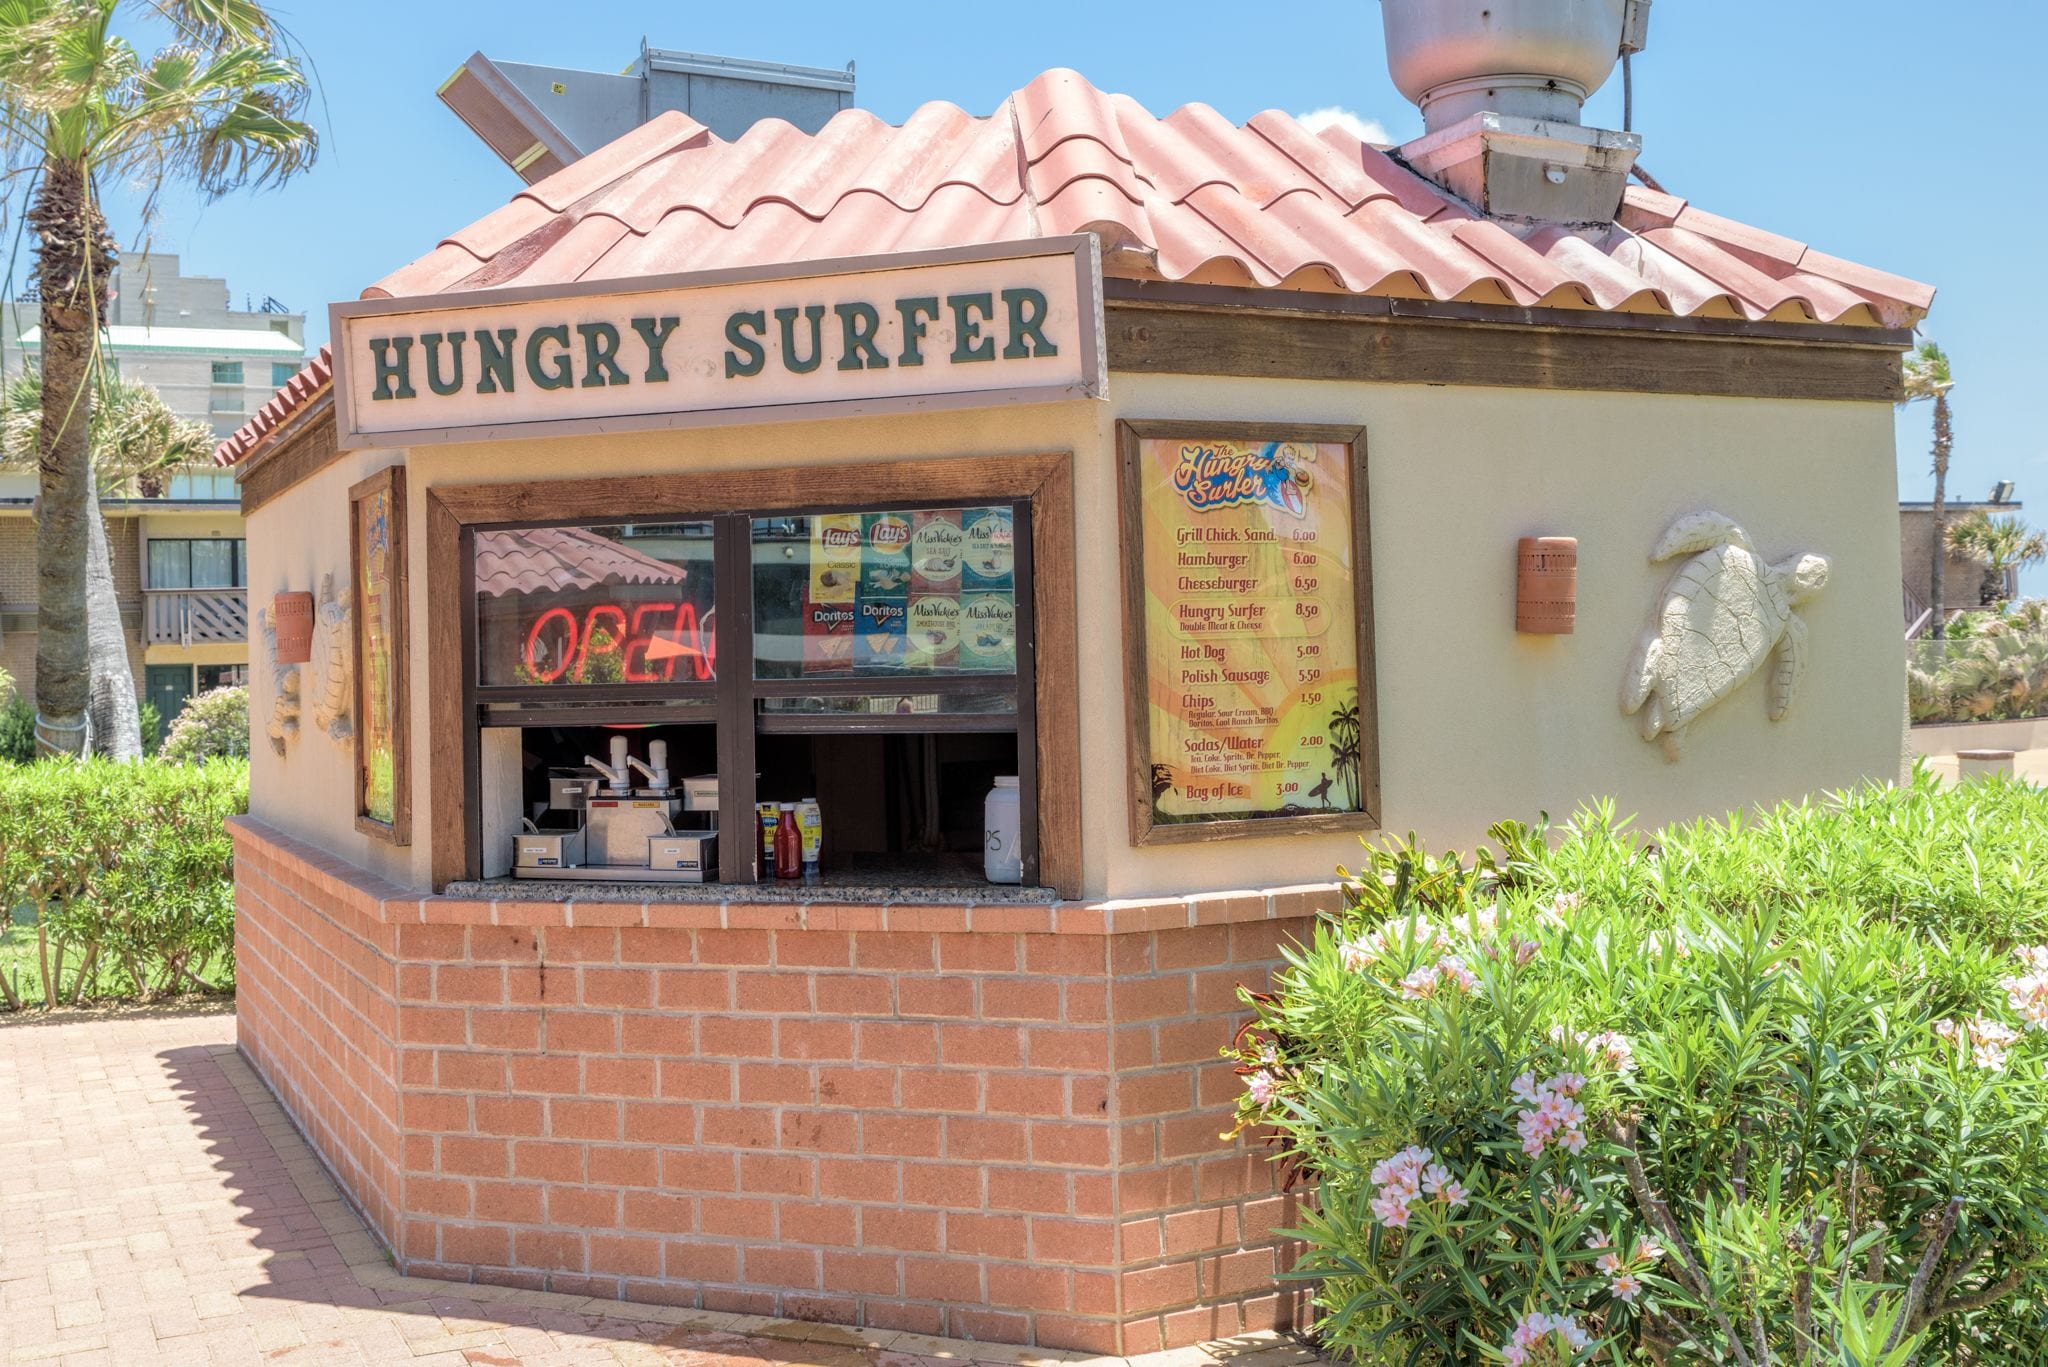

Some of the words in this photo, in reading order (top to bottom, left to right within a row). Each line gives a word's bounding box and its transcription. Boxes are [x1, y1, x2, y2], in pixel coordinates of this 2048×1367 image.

[369, 317, 681, 400] HUNGRY
[723, 288, 1059, 379] SURFER
[1213, 444, 1235, 457] The
[1174, 446, 1271, 490] Hungry
[1187, 468, 1267, 506] Surfer
[1177, 528, 1203, 545] Grill
[1206, 528, 1241, 541] Chick.
[1244, 528, 1277, 541] Sand.
[1293, 529, 1316, 541] 6.00
[827, 560, 856, 569] Classic
[1178, 552, 1248, 569] Hamburger
[1293, 552, 1317, 564] 6.00
[1178, 576, 1258, 593] Cheeseburger
[1295, 576, 1317, 591] 6.50
[814, 611, 854, 622] Doritos
[863, 605, 904, 617] Doritos
[1180, 604, 1225, 621] Hungry
[1228, 604, 1265, 620] Surfer
[1296, 603, 1318, 617] 8.50
[1180, 621, 1206, 631] Double
[1208, 621, 1228, 631] Meat
[1229, 621, 1236, 630] &
[1237, 620, 1262, 630] Cheese
[1181, 646, 1201, 659] Hot
[1204, 645, 1225, 661] Dog
[1297, 645, 1320, 658] 5.00
[1182, 669, 1218, 683] Polish
[1222, 669, 1270, 684] Sausage
[1299, 669, 1320, 682] 5.50
[1182, 694, 1215, 710] Chips
[1301, 693, 1321, 705] 1.50
[1218, 709, 1233, 718] Sour
[1261, 707, 1274, 716] BBQ
[1216, 718, 1230, 727] Cool
[1232, 716, 1253, 726] Ranch
[1255, 715, 1279, 725] Doritos
[1185, 736, 1264, 753] Sodas/Water
[1300, 736, 1323, 746] 2.00
[1246, 752, 1255, 760] Dr.
[1191, 766, 1204, 774] Diet
[1224, 763, 1237, 772] Diet
[1262, 762, 1274, 770] Diet
[1276, 761, 1286, 769] Dr.
[1287, 760, 1310, 770] Pepper
[1187, 785, 1208, 801] Bag
[1212, 784, 1225, 799] of
[1228, 783, 1243, 796] Ice
[1276, 783, 1298, 796] 3.00
